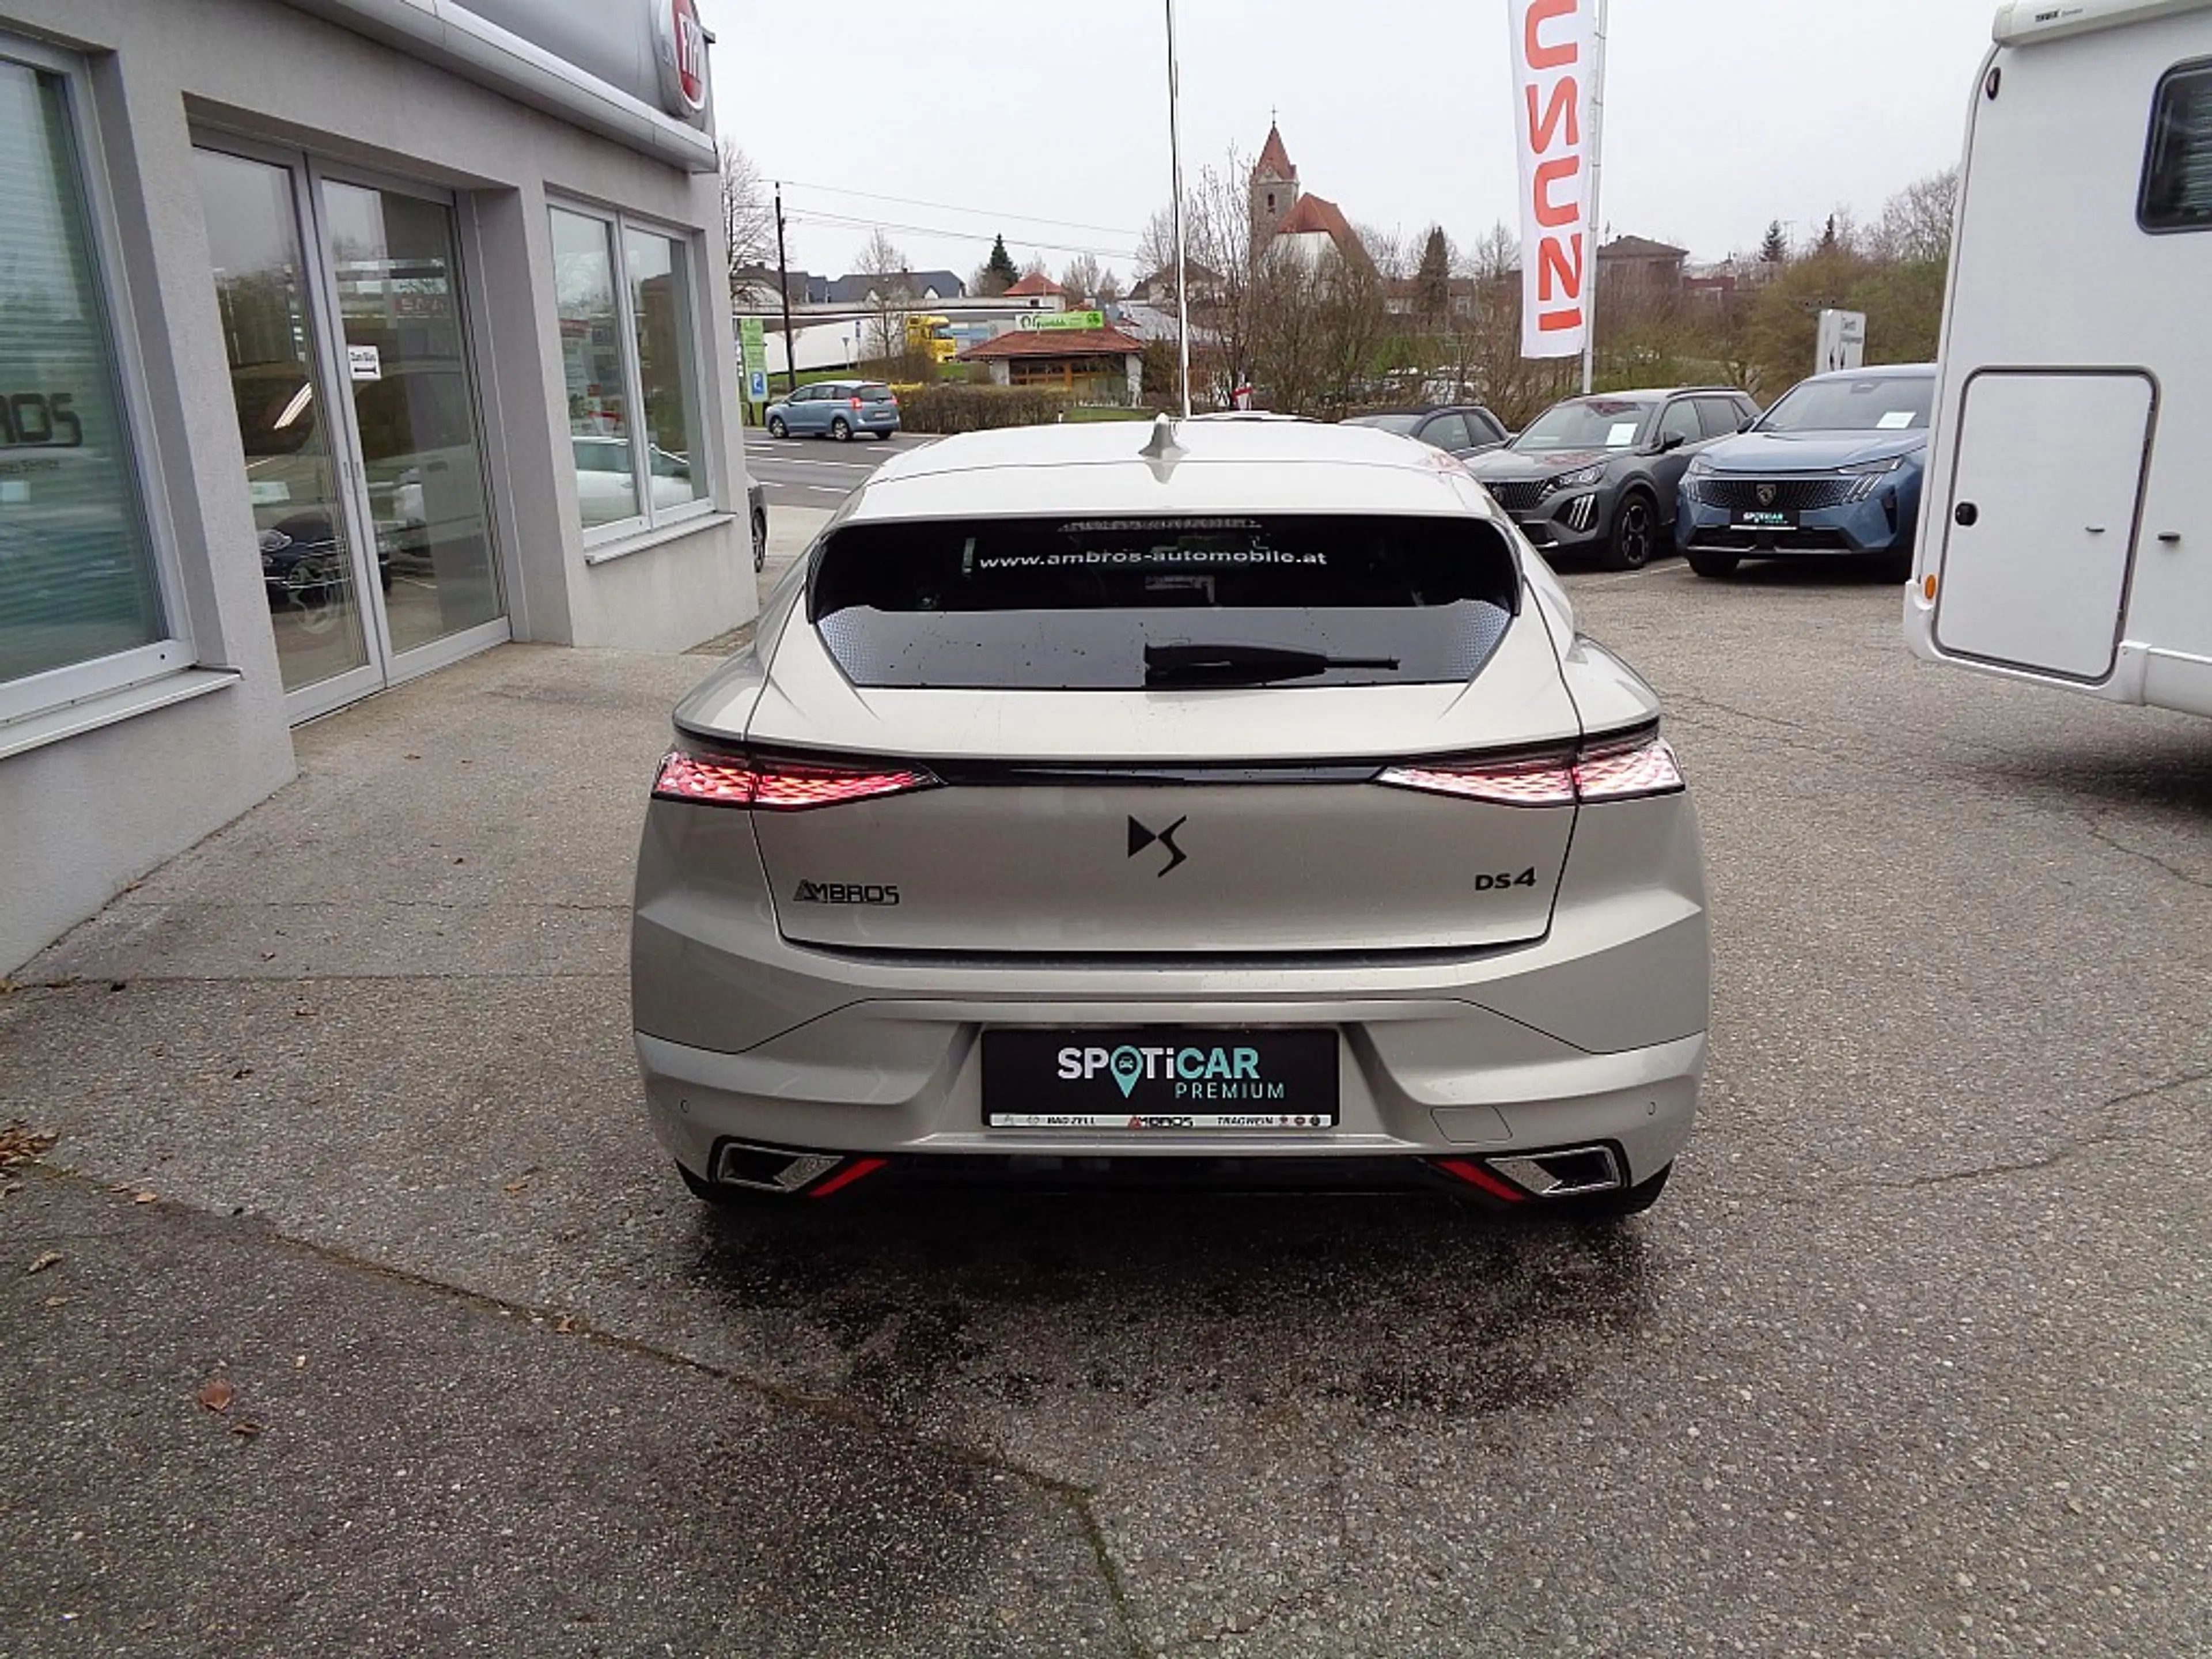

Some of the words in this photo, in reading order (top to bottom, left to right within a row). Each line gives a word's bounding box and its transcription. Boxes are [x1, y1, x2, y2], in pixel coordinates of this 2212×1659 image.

[980, 550, 1327, 569] www.ambros-automobile.at
[793, 879, 899, 905] AMBROS
[1175, 1082, 1285, 1099] PREMIUM
